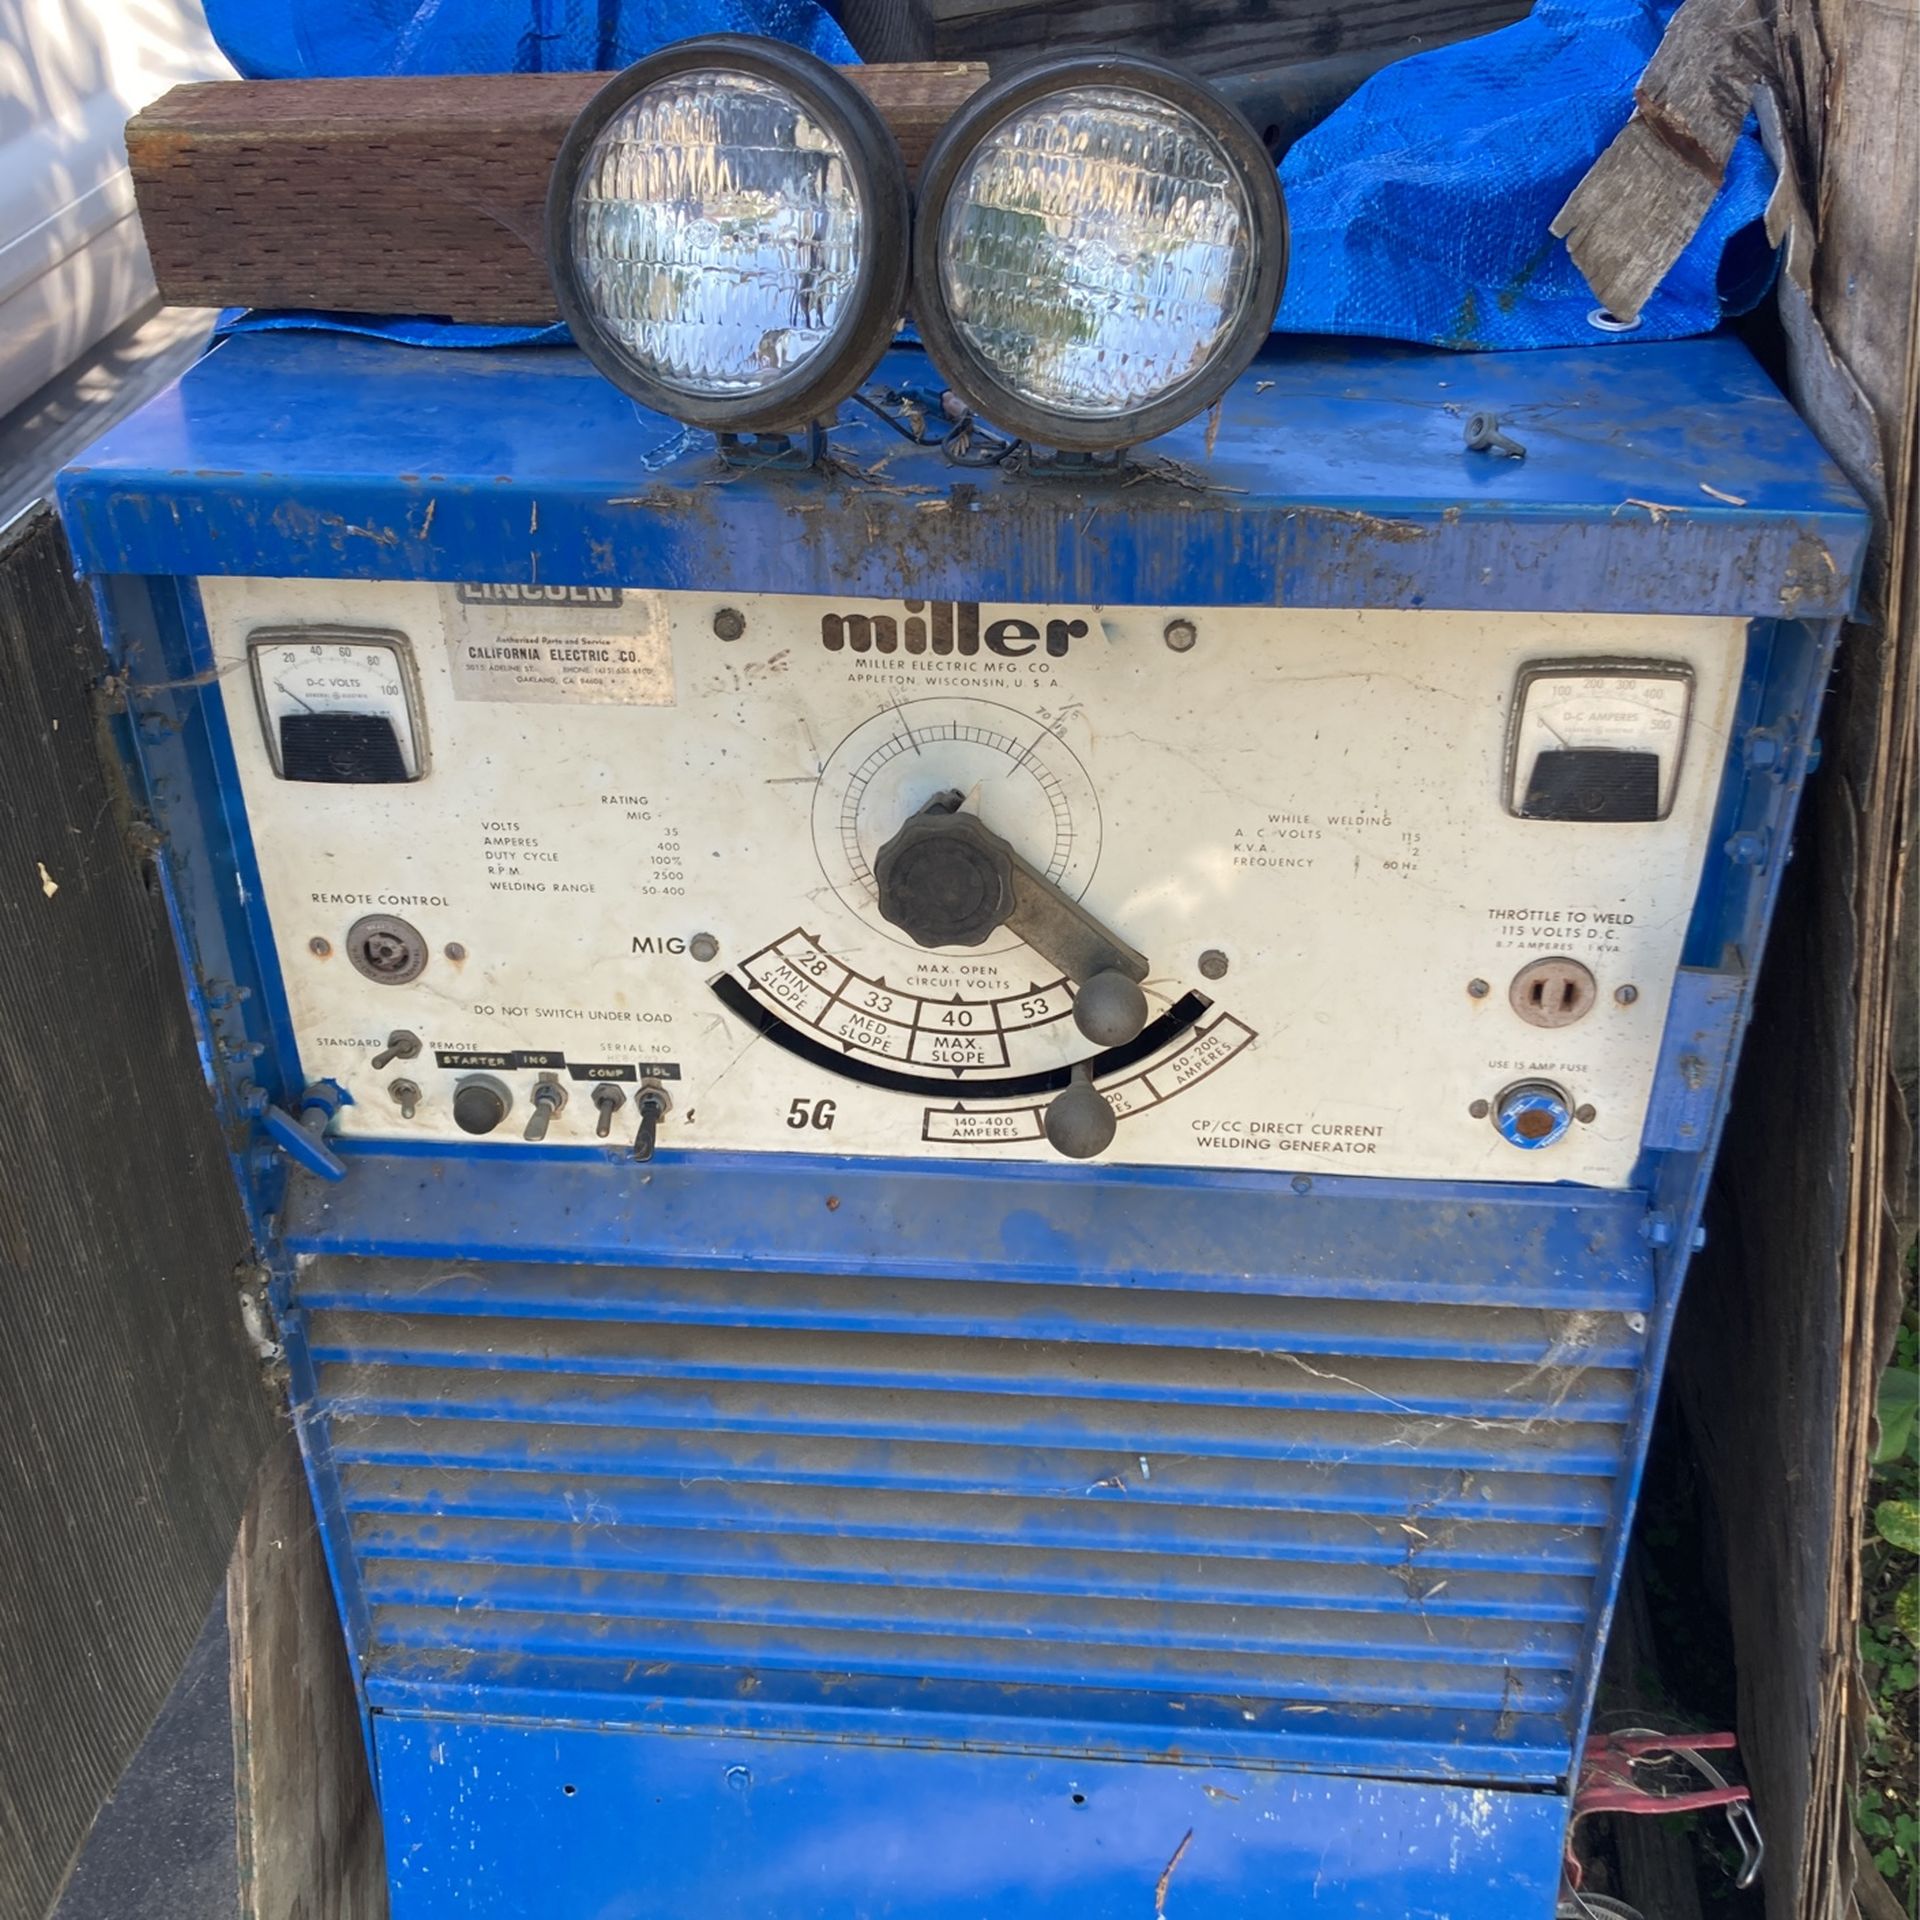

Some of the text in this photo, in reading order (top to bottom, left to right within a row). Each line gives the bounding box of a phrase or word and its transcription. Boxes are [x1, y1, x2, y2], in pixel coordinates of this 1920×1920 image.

[821, 600, 1089, 658] miller
[565, 637, 579, 645] and
[582, 637, 611, 646] Service
[310, 645, 323, 656] 40
[338, 646, 352, 658] 60
[468, 646, 641, 663] CALIFORNIA ELECTRIC CO.
[282, 652, 296, 663] 20
[366, 655, 380, 666] 80
[855, 658, 905, 670] MILLER
[911, 660, 977, 672] ELECTRIC
[307, 678, 361, 688] D-C VOLTS
[563, 677, 575, 685] CA
[381, 685, 399, 696] 100
[1588, 712, 1638, 722] AMPERES
[601, 795, 648, 806] RATING
[626, 811, 651, 821] MIG
[1268, 814, 1392, 827] WHILE WELDING
[481, 821, 520, 831] VOLTS
[664, 827, 679, 837] 35
[1278, 829, 1321, 839] VOLTS
[484, 836, 539, 847] AMPERES
[657, 841, 680, 851] 400
[485, 850, 559, 862] DUTY CYCLE
[1412, 847, 1420, 856] 2
[651, 855, 682, 866] 100%
[1233, 856, 1313, 867] FREQUENCY
[1382, 860, 1398, 870] 60
[653, 871, 684, 880] 2500
[490, 881, 596, 893] WELDING RANGE
[642, 885, 685, 896] 50-400
[311, 893, 450, 907] REMOTE CONTROL
[1488, 908, 1635, 925] THROTTLE TO WELD
[1501, 925, 1525, 936] 115
[1532, 926, 1581, 938] VOLTS
[632, 936, 686, 955] MIG
[1517, 941, 1573, 951] AMPERES
[798, 950, 828, 977] 28
[960, 965, 998, 976] OPEN
[775, 965, 809, 998] MIN.
[906, 976, 1010, 990] CIRCUIT VOLTS
[760, 971, 807, 1012] SLOPE
[863, 991, 894, 1013] 33
[1021, 997, 1049, 1019] 53
[474, 1005, 673, 1023] DO NOT SWITCH UNDER LOAD
[941, 1010, 973, 1027] 40
[849, 1014, 890, 1038] MED.
[316, 1037, 382, 1048] STANDARD
[838, 1024, 893, 1053] SLOPE
[934, 1036, 982, 1050] MAX.
[430, 1041, 478, 1051] REMOTE
[600, 1042, 644, 1052] SERIAL
[523, 1055, 548, 1065] ING
[931, 1050, 985, 1064] SLOPE
[1172, 1035, 1219, 1073] 60-200
[443, 1055, 505, 1067] STARTER
[1176, 1041, 1233, 1085] AMPERES
[1488, 1060, 1589, 1073] USE 15 AMP FUSE
[588, 1068, 625, 1078] COMP
[646, 1065, 671, 1077] IDL
[786, 1097, 837, 1131] 5G
[953, 1116, 1014, 1127] 140-400
[952, 1127, 1019, 1138] AMPERES
[1191, 1119, 1384, 1137] CP/CC DIRECT CURRENT
[1197, 1137, 1377, 1154] WELDING GENERATOR
